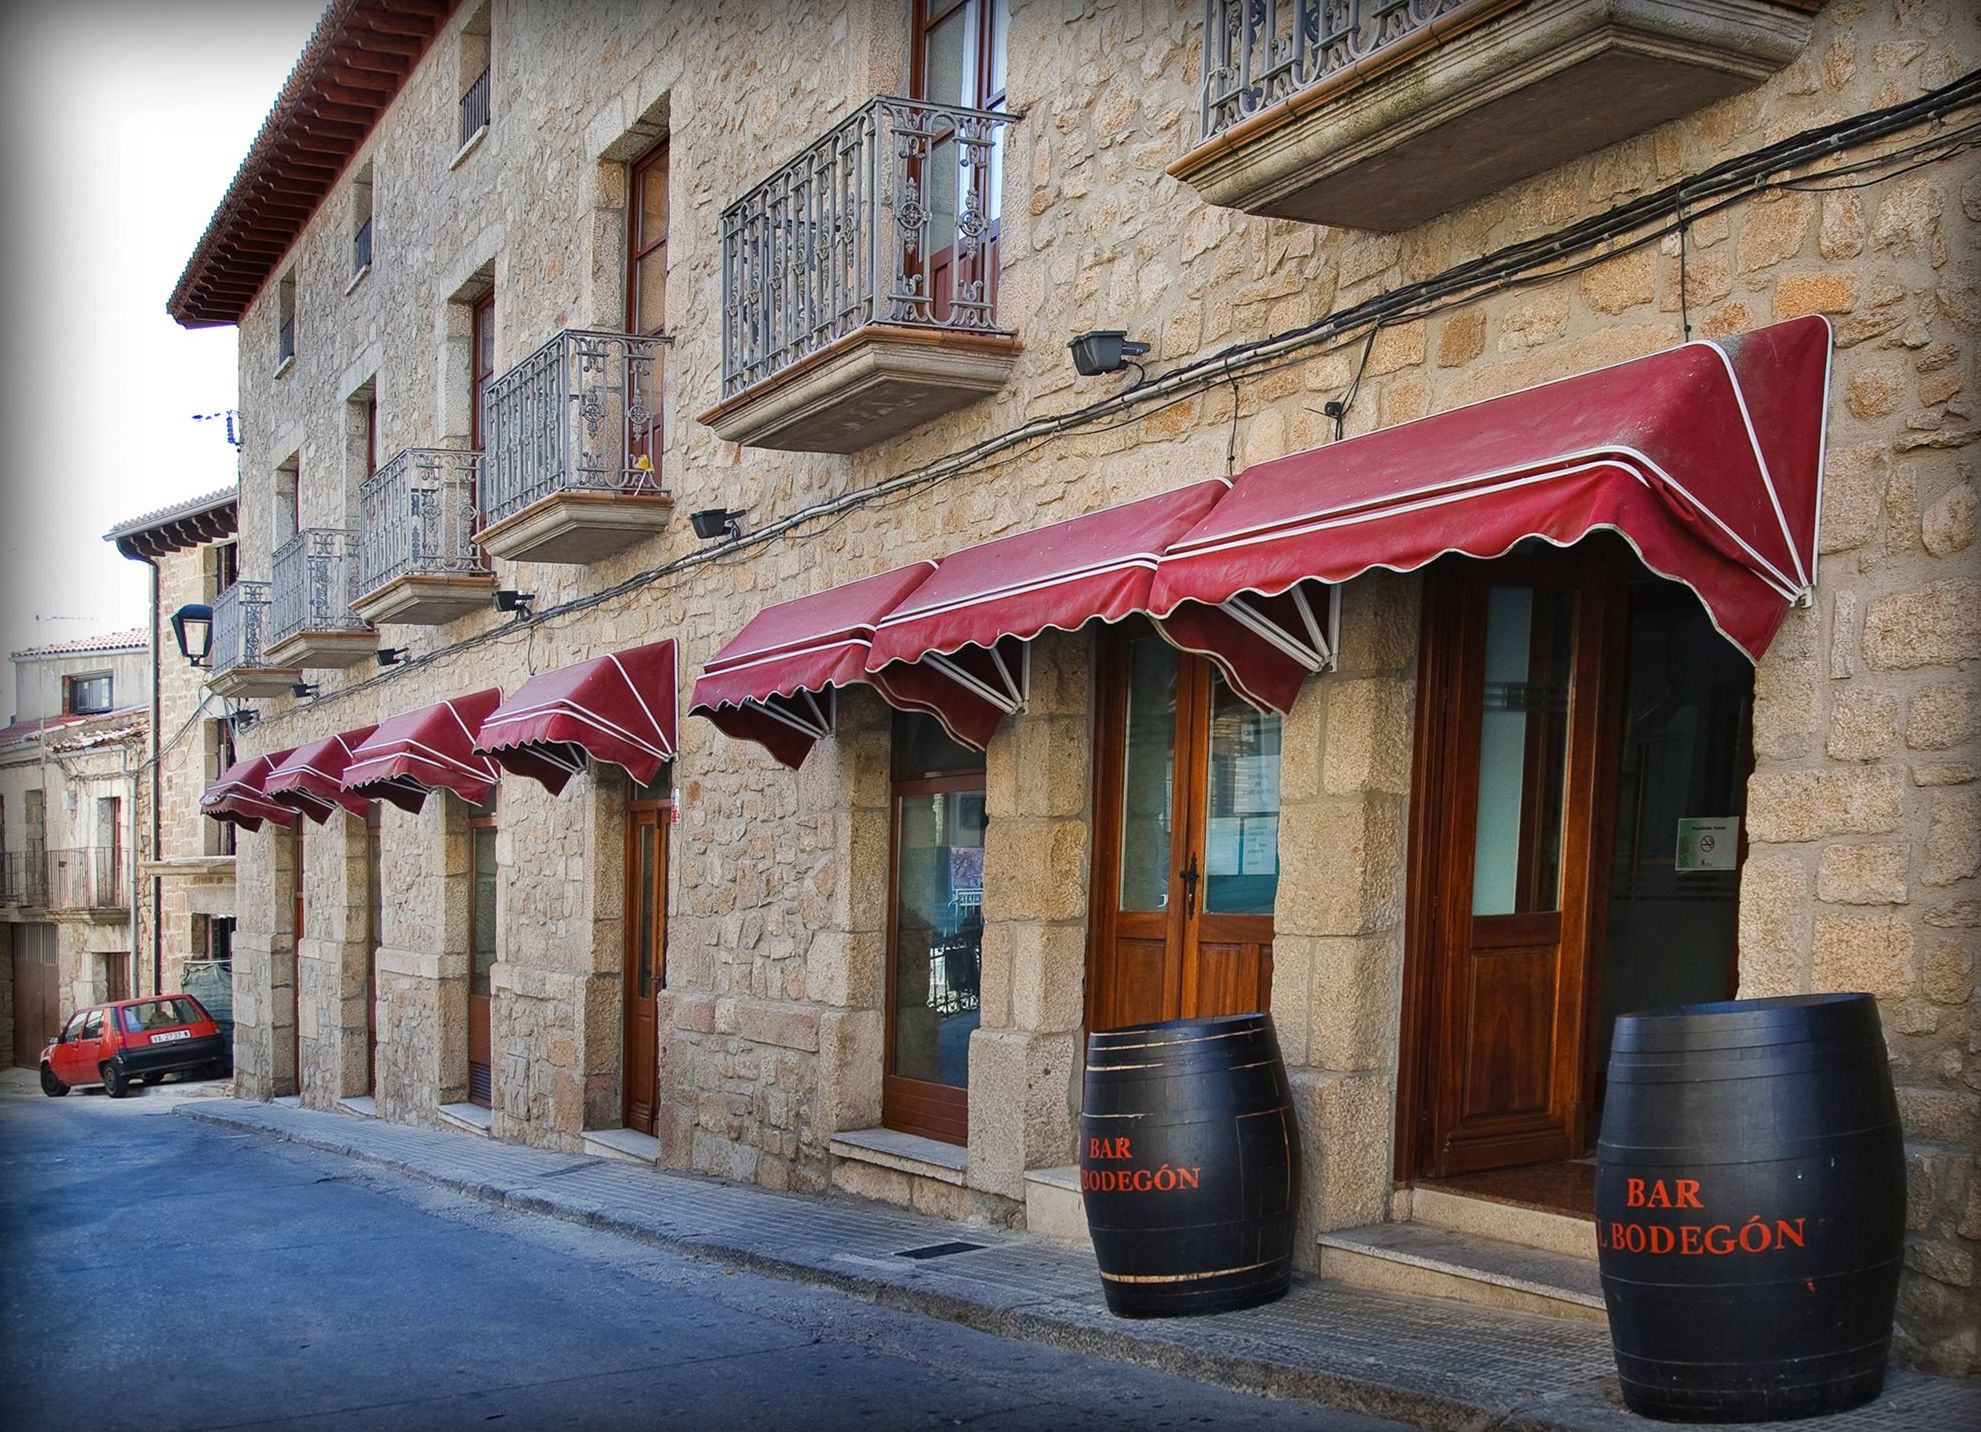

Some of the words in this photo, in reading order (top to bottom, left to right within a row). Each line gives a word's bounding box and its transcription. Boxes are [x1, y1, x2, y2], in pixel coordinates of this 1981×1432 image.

[1089, 1137, 1132, 1159] BAR
[1082, 1163, 1200, 1192] BODEGÓN
[1626, 1177, 1705, 1209] BAR
[1610, 1214, 1806, 1255] BODEGÓN
